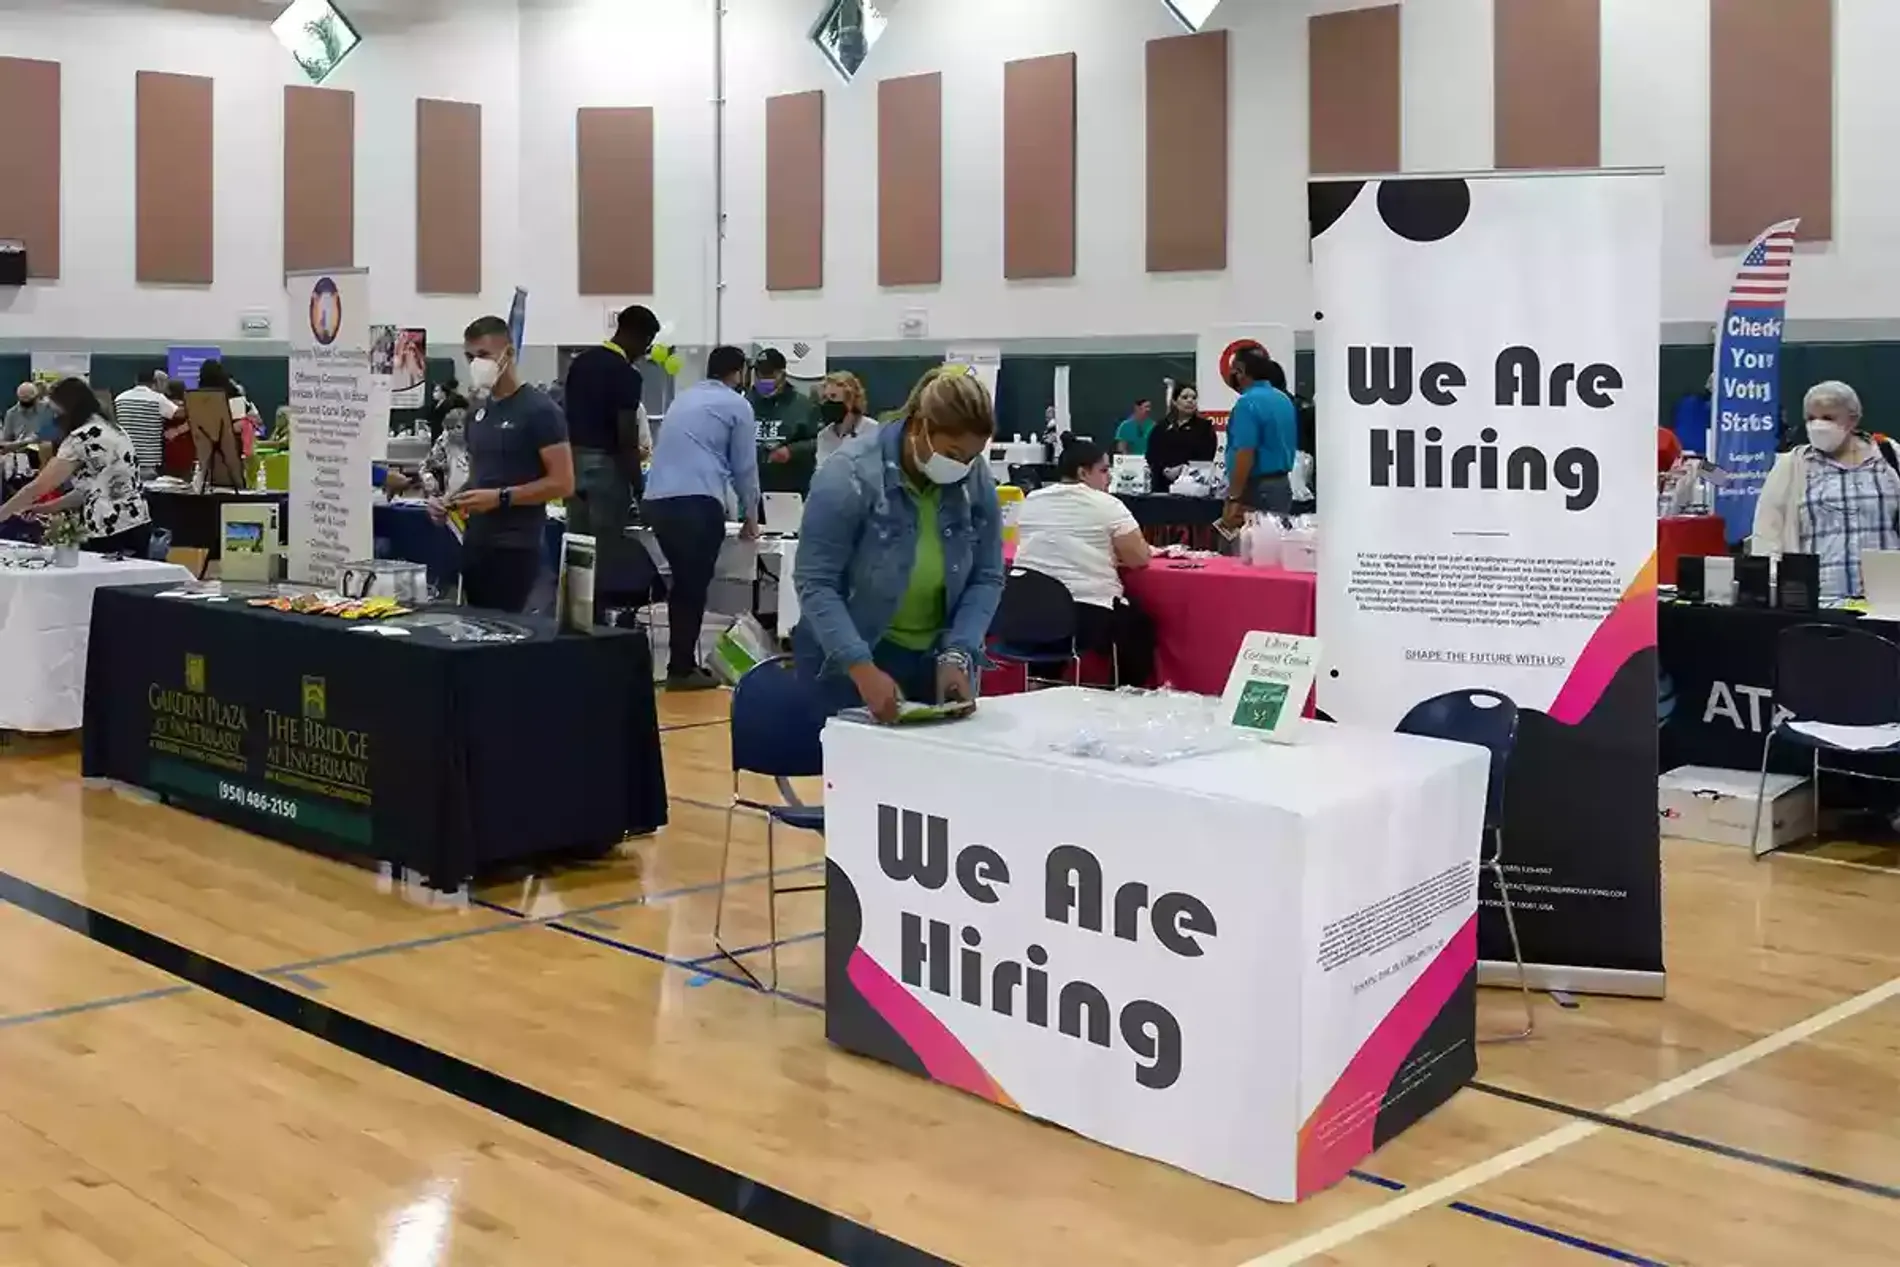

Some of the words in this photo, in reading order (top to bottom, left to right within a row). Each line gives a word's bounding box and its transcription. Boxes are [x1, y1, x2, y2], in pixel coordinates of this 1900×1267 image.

[1348, 347, 1467, 405] We
[1495, 346, 1623, 408] Are
[1370, 427, 1600, 511] Hiring
[1405, 650, 1441, 660] SHAPE
[1447, 651, 1466, 661] THE
[1470, 652, 1512, 664] FUTURE
[303, 717, 370, 761] BRIDGE
[218, 780, 245, 806] (954)
[247, 791, 298, 820] 486-2150
[878, 803, 1010, 904] We
[1045, 844, 1217, 957] Are
[901, 911, 1182, 1089] Hiring
